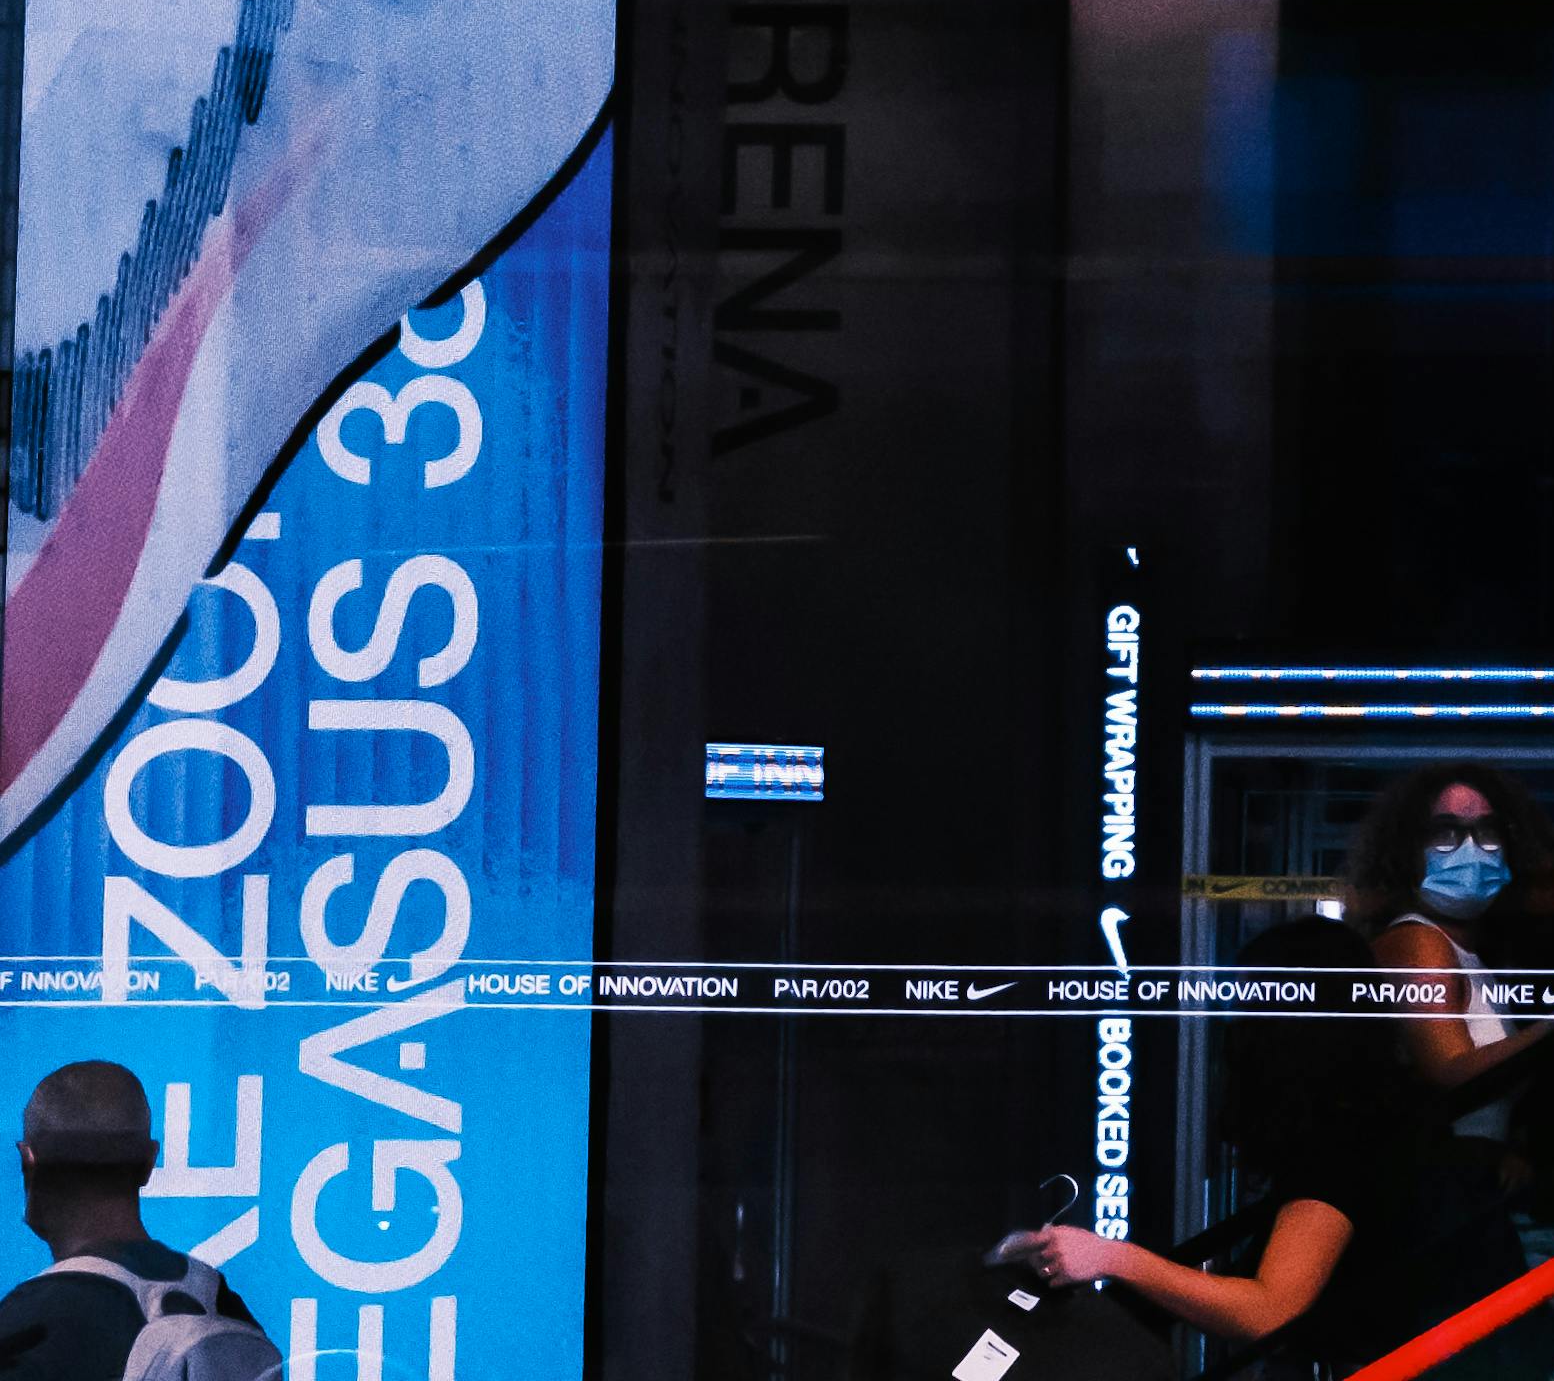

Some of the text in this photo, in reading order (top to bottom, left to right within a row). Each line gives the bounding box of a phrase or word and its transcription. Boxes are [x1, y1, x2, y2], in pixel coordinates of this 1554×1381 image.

[1106, 604, 1141, 684] GIFT
[102, 512, 281, 1009] ZOO
[1102, 689, 1138, 880] WRAPPING
[22, 972, 159, 992] INNOVAON
[326, 974, 378, 994] NIKE
[469, 975, 549, 995] HOUSE
[559, 976, 591, 996] OF
[600, 975, 738, 997] INNOVATION
[775, 979, 869, 999] PAR/002
[906, 980, 958, 1000] NIKE
[1049, 980, 1128, 1001] HOUSE
[1138, 980, 1169, 1001] OF
[1178, 980, 1315, 1002] INNOVATION
[1352, 983, 1446, 1004] PAR/002
[1482, 983, 1534, 1005] NIKE
[1096, 1017, 1132, 1168] BOOKED
